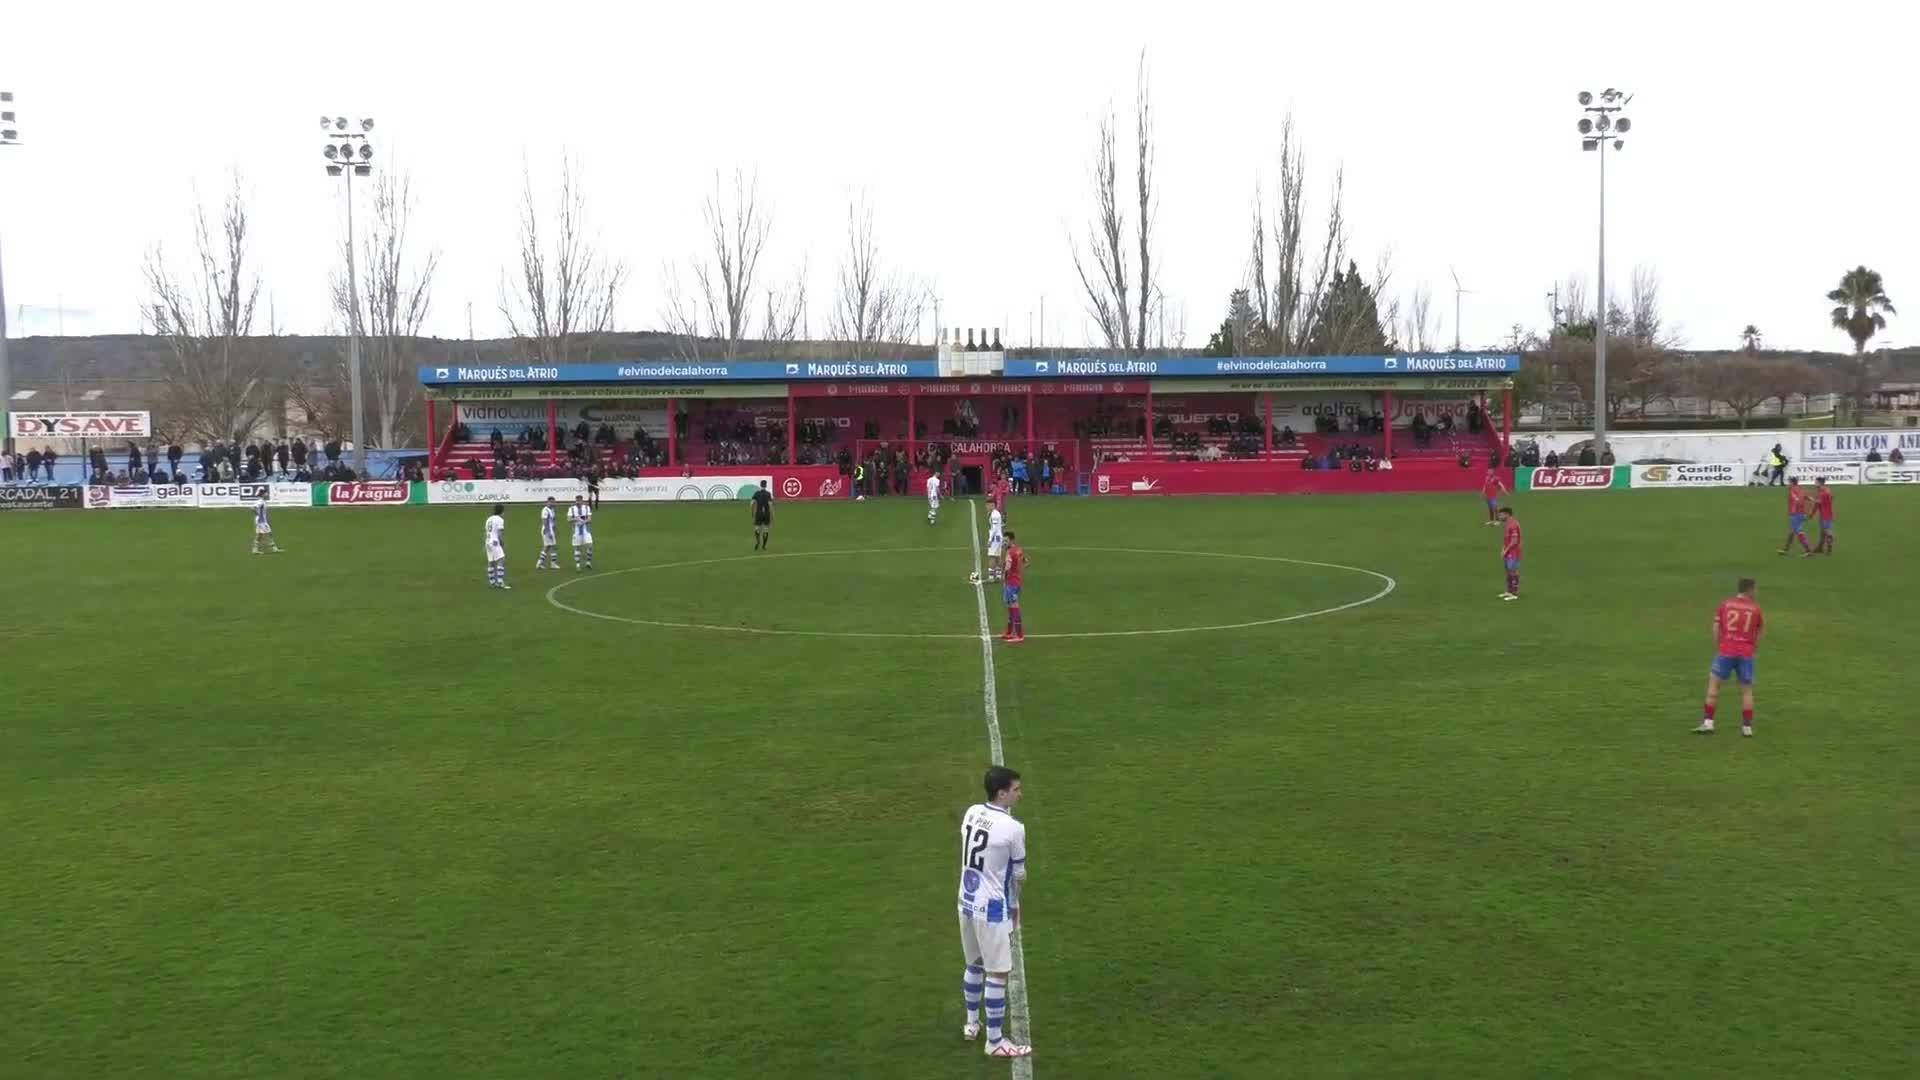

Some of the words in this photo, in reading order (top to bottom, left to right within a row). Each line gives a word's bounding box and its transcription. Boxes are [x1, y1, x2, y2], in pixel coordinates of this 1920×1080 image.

[808, 362, 857, 376] MARQUÉS
[859, 365, 875, 374] DEL
[877, 363, 908, 375] ATRIO
[1057, 360, 1107, 375] MARQUÉS
[1109, 364, 1125, 373] DEL
[1126, 361, 1158, 373] ATRIO
[1217, 360, 1326, 371] #elvinodelcalahorra
[1407, 356, 1456, 370] MARQUÉS
[1458, 360, 1474, 369] DEL
[1475, 357, 1506, 369] ATRIO
[458, 366, 508, 380] MARQUÉS
[510, 369, 526, 379] DEL
[527, 367, 558, 379] ATRIO
[618, 365, 728, 376] #elvinodelcalahorra
[17, 418, 142, 433] DYSAVE
[1810, 435, 1827, 450] EL
[1836, 434, 1888, 450] RINCON
[1677, 464, 1731, 473] Castillo
[1538, 470, 1552, 484] la
[1553, 470, 1605, 486] fragua
[1677, 473, 1732, 481] Arnedo
[60, 487, 78, 500] 21
[157, 486, 192, 499] gala
[336, 484, 349, 499] la
[350, 484, 402, 502] fragua
[1727, 609, 1753, 633] 21
[965, 824, 989, 872] 12
